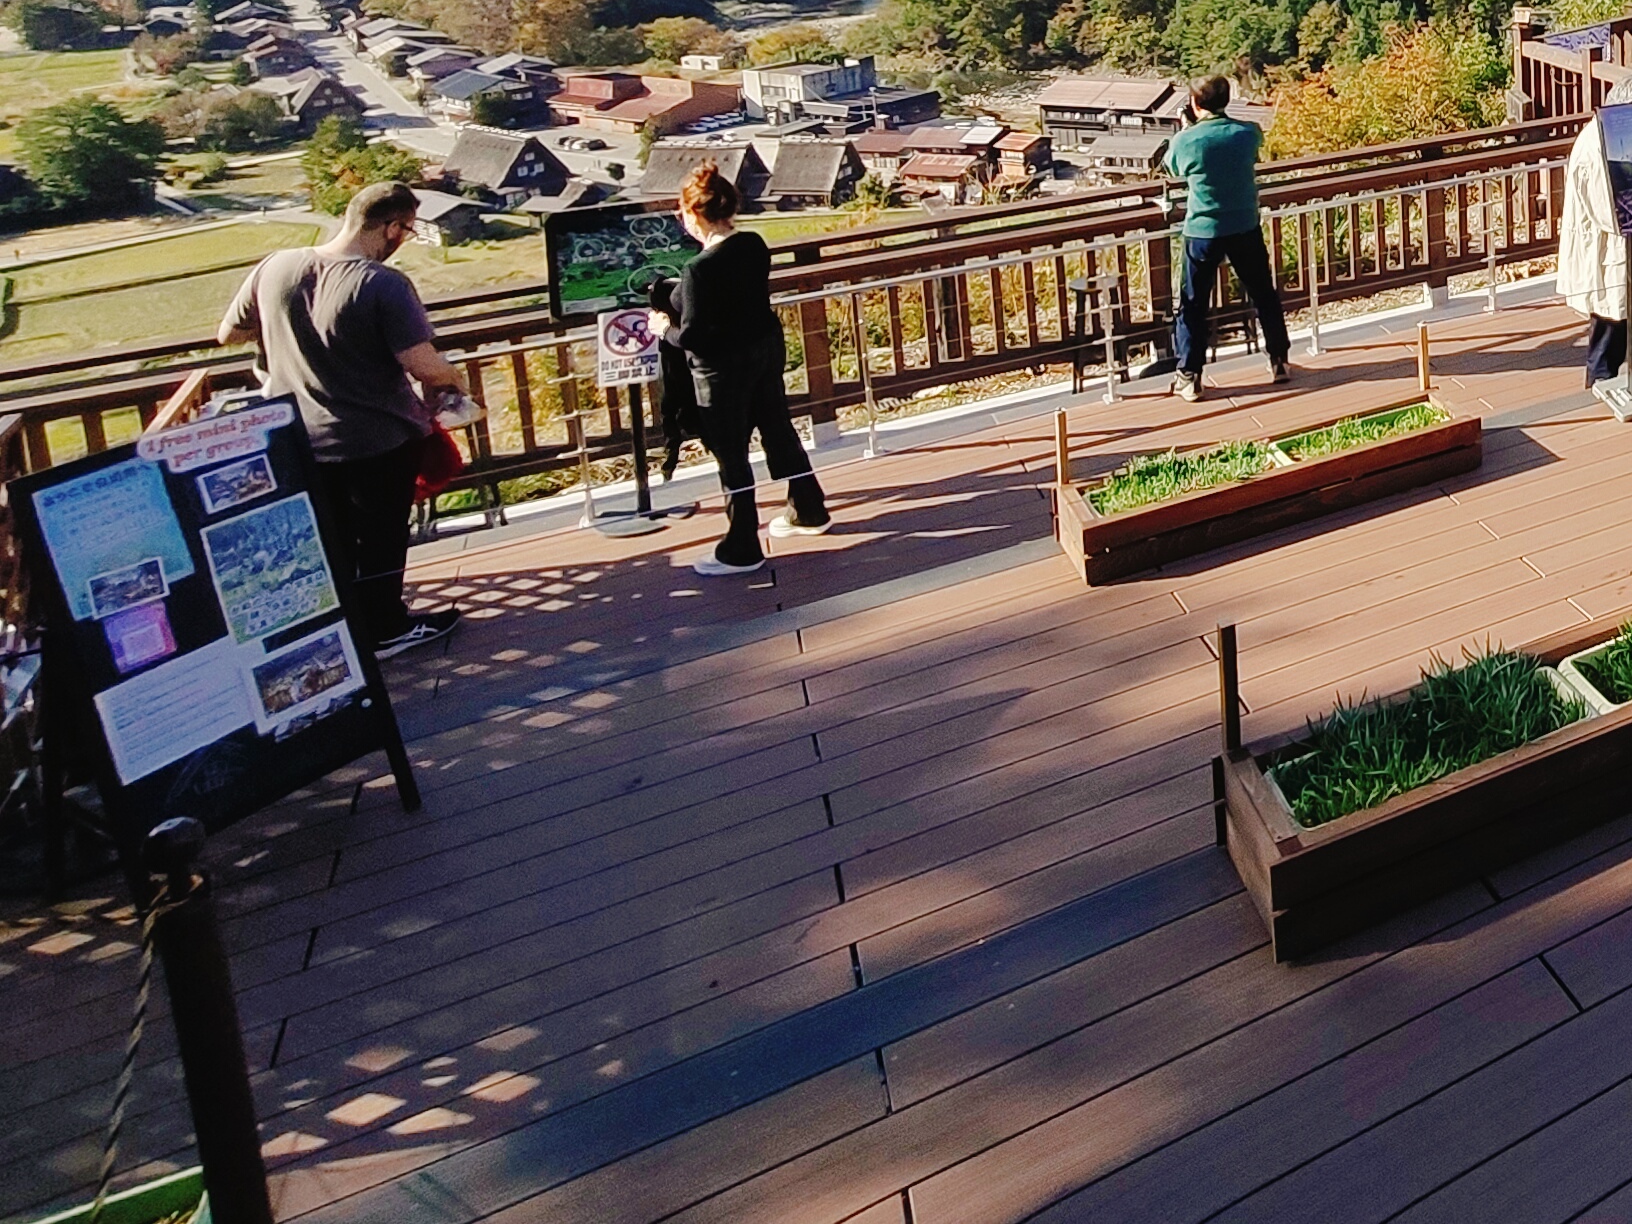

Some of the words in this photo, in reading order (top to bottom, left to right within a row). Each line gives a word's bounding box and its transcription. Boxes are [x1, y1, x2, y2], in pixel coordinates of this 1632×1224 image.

[157, 433, 192, 454] free
[197, 419, 237, 440] mini
[240, 410, 287, 433] photo
[172, 448, 202, 467] per
